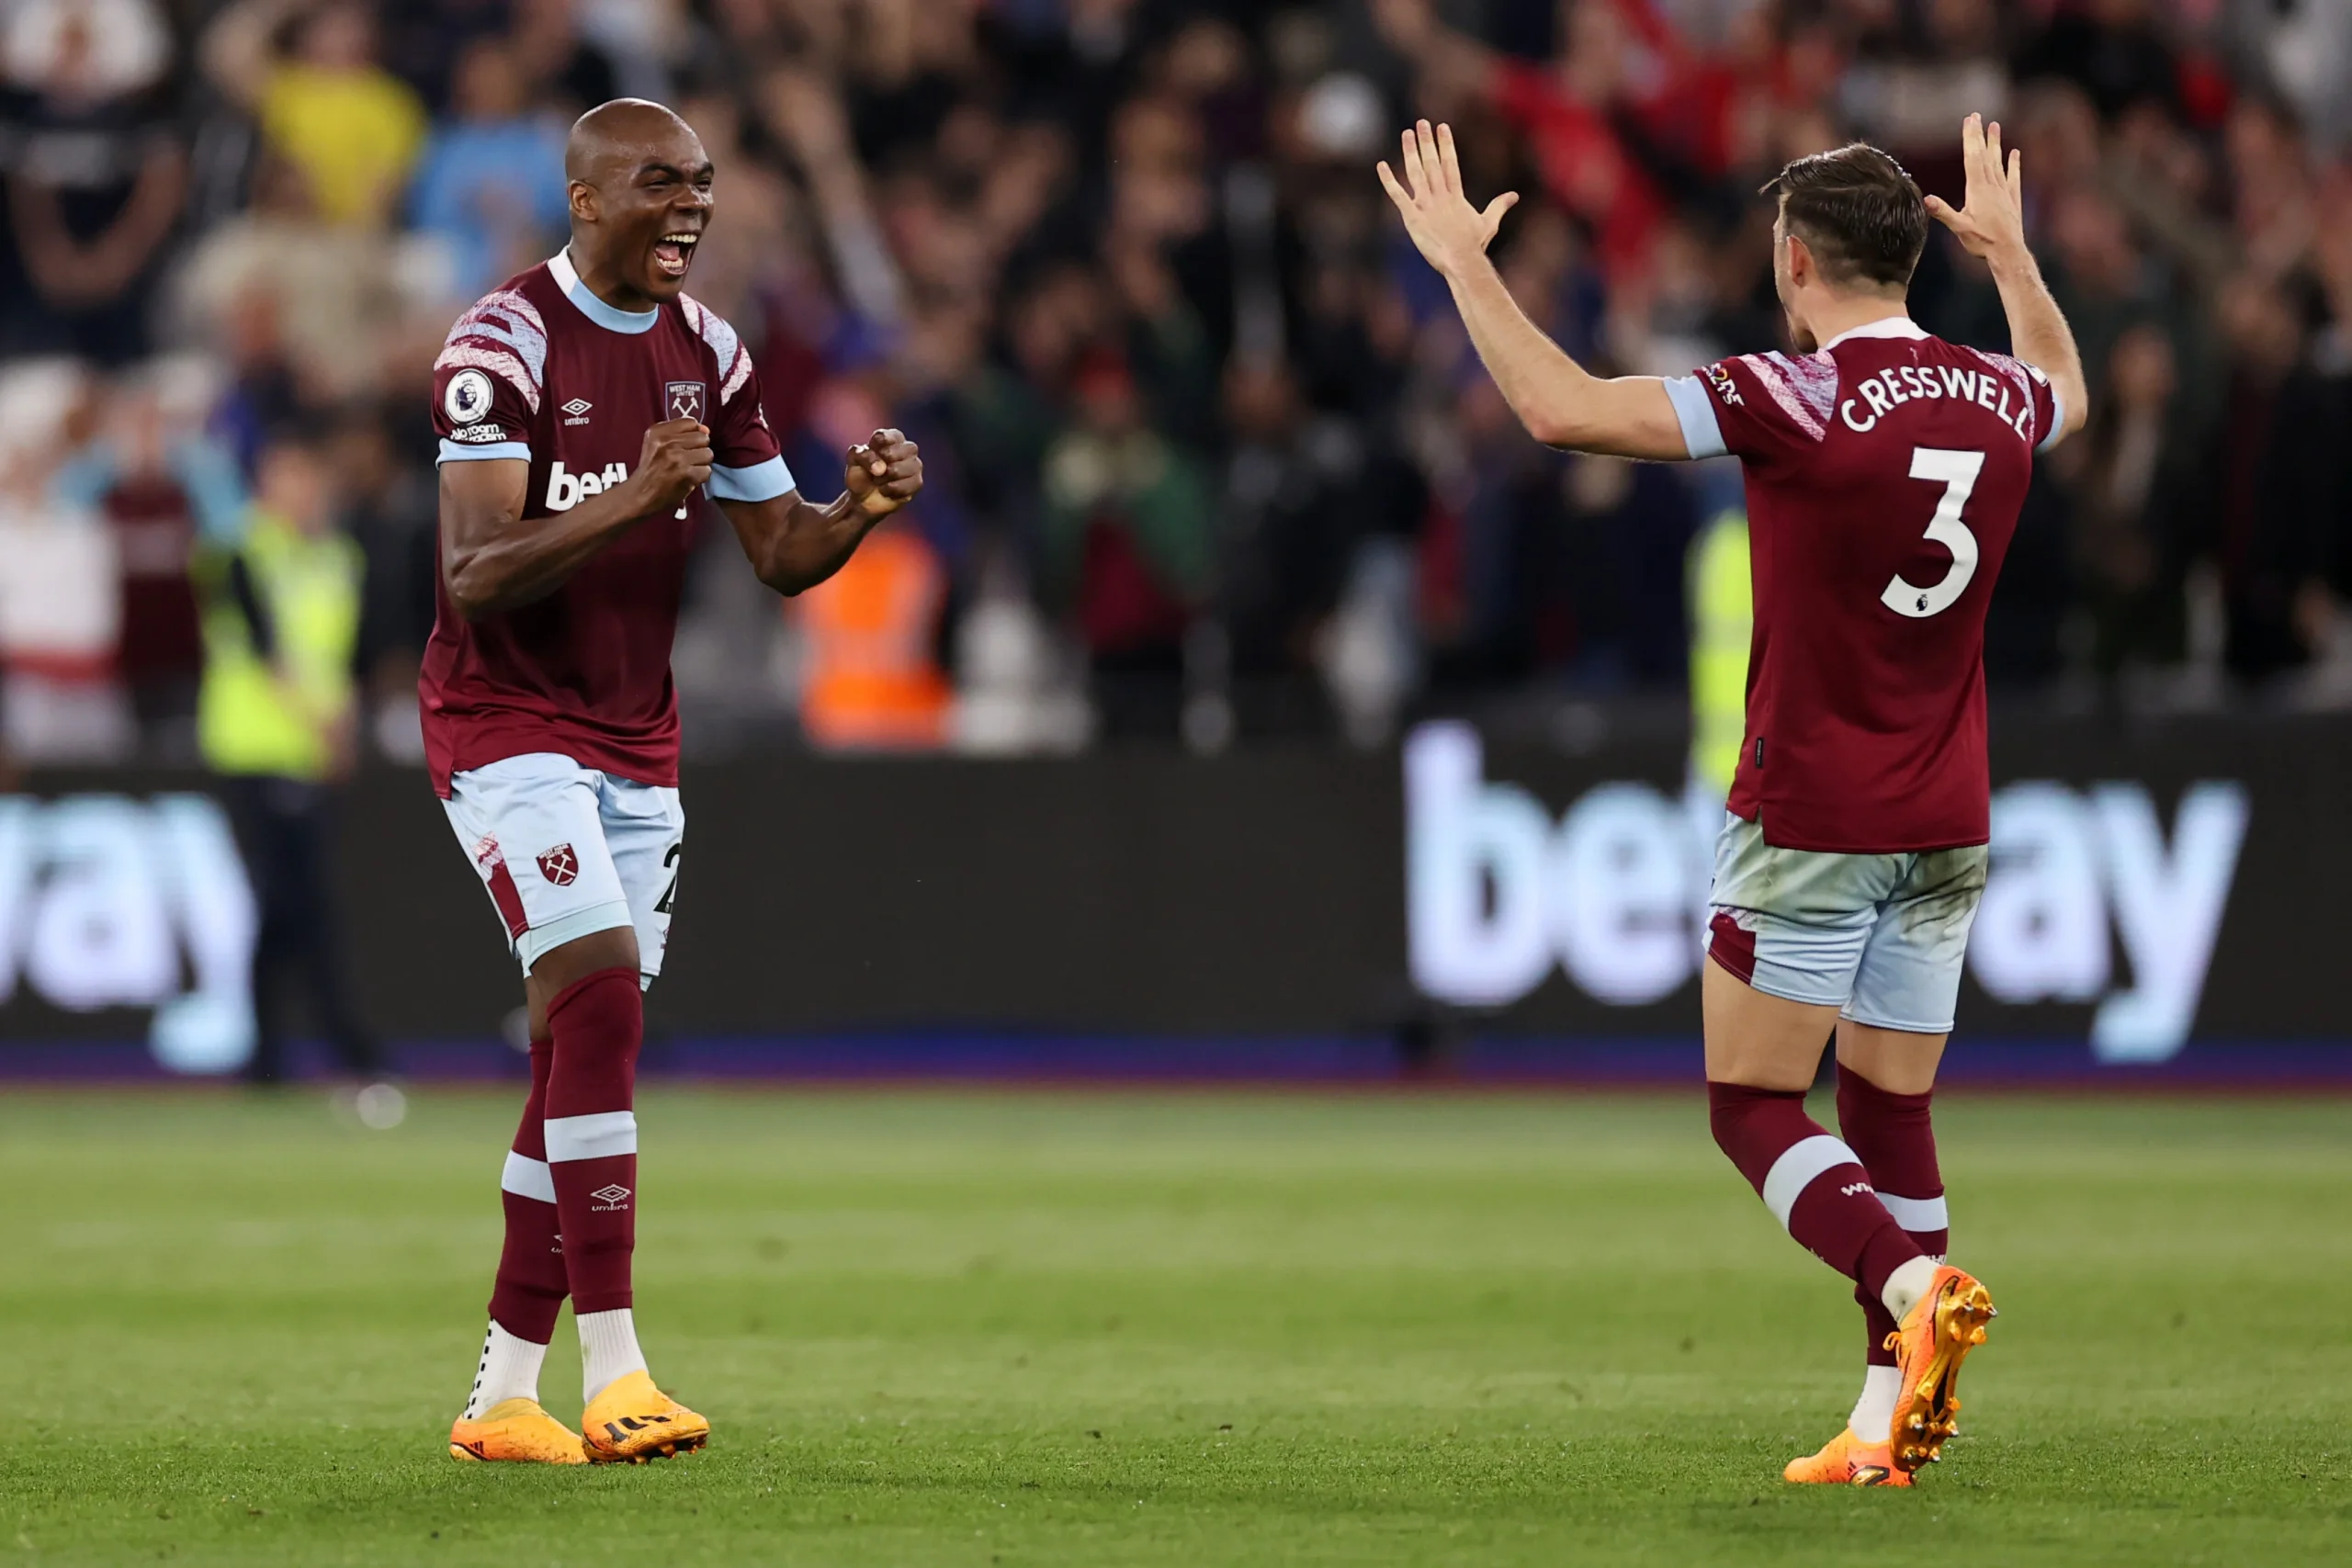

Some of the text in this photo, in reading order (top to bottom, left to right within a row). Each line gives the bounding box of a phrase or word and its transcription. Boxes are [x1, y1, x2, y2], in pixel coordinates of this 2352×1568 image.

[451, 428, 468, 440] No
[467, 423, 500, 436] room
[564, 416, 590, 425] umbro
[1841, 366, 2029, 441] CRESSWELL
[1880, 446, 1985, 618] 3
[1405, 720, 2250, 1064] beay
